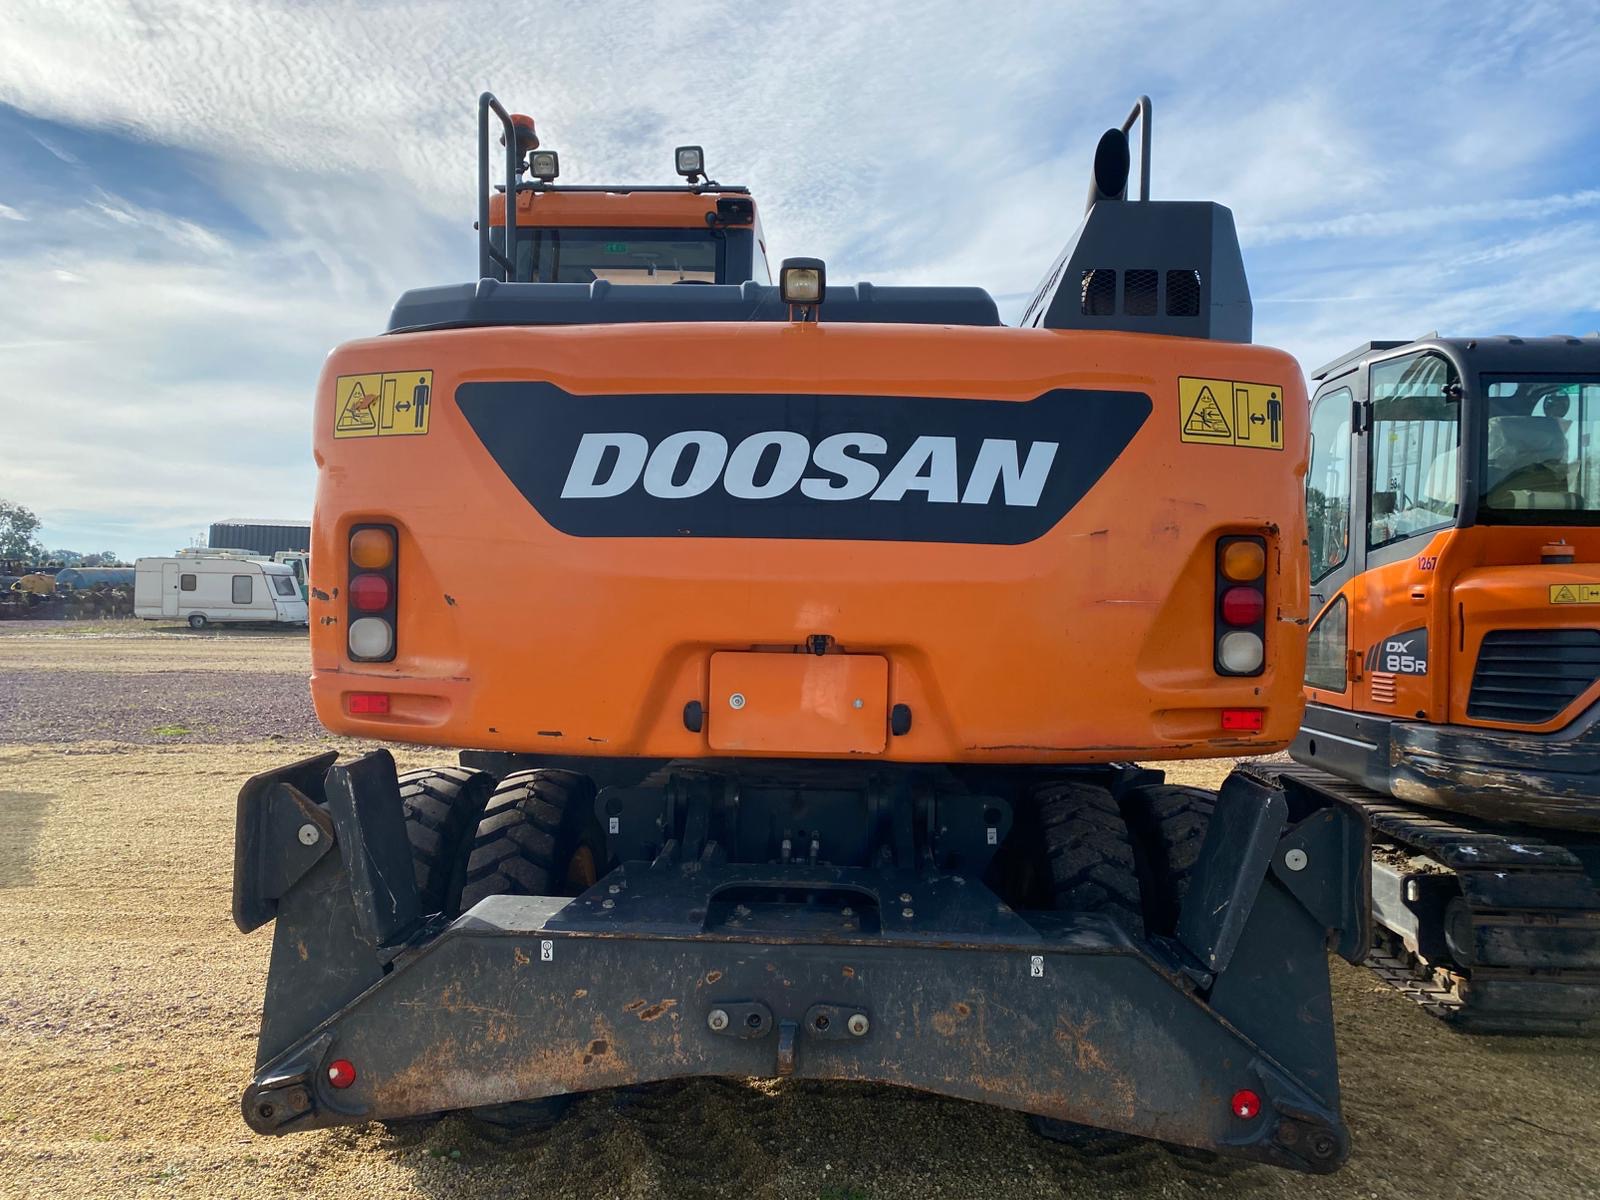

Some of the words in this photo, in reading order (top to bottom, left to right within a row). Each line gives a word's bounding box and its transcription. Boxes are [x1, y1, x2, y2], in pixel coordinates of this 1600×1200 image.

[560, 430, 1060, 507] DOOSAN
[1418, 556, 1438, 571] 1267
[1386, 639, 1415, 653] DX
[1386, 655, 1427, 673] 85R
